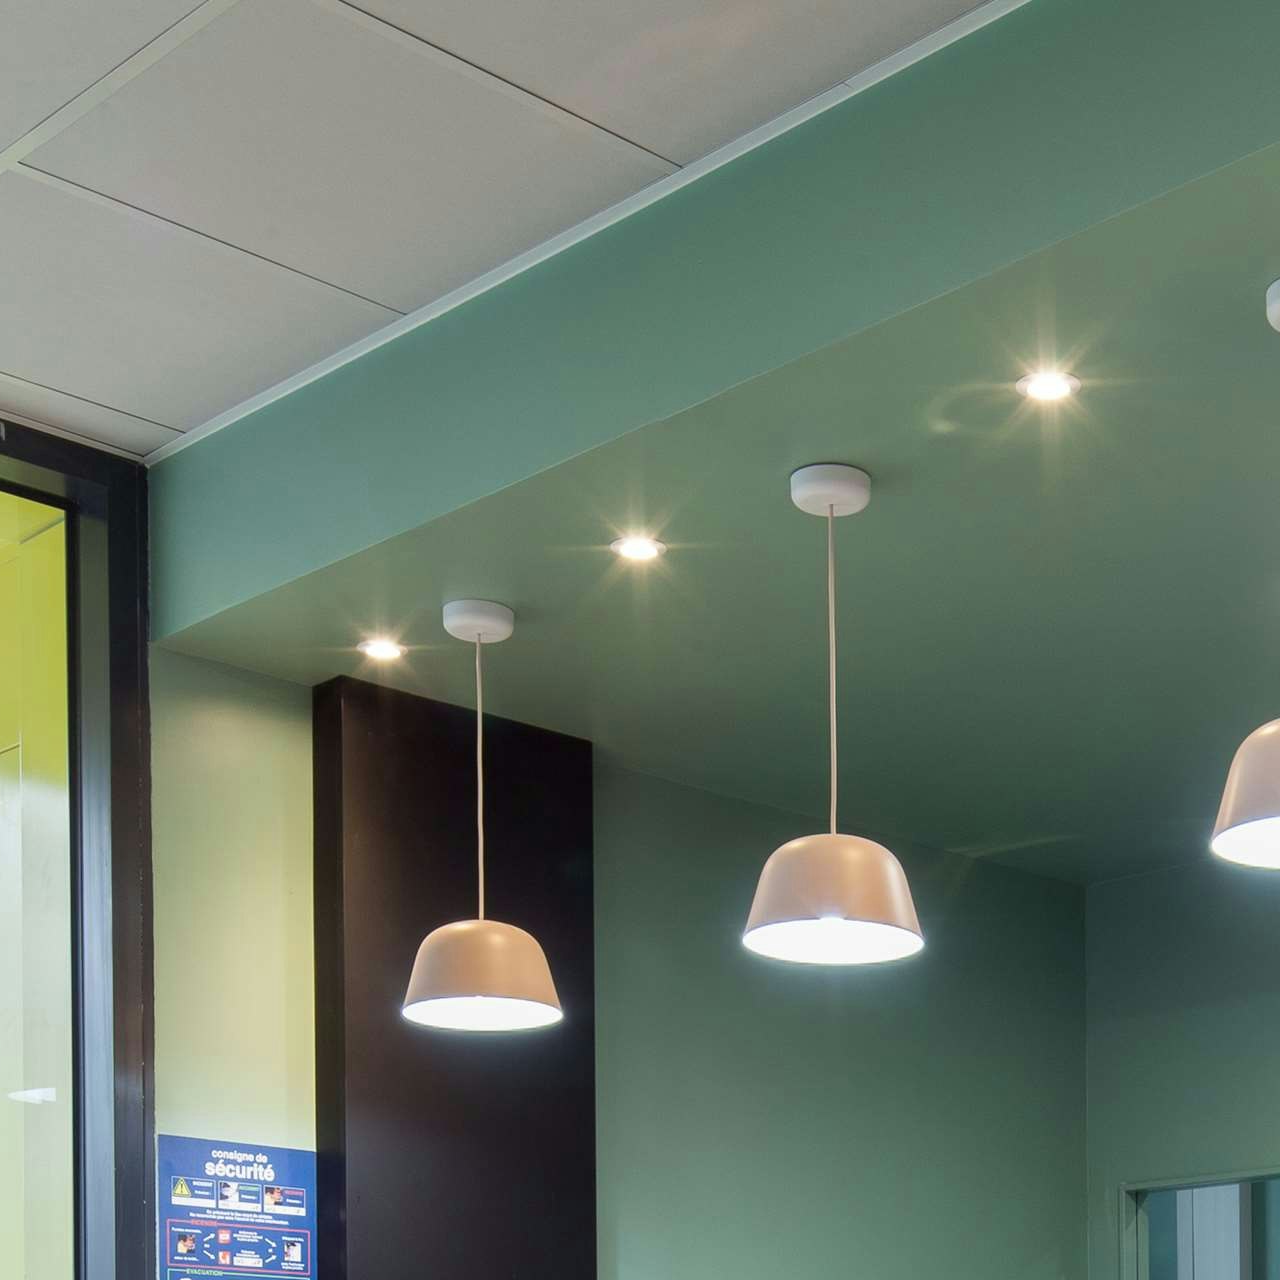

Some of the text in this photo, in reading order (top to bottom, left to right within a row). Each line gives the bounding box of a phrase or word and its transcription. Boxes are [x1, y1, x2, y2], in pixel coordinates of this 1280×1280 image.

[211, 1150, 268, 1163] consigne de
[205, 1160, 275, 1182] sécurité
